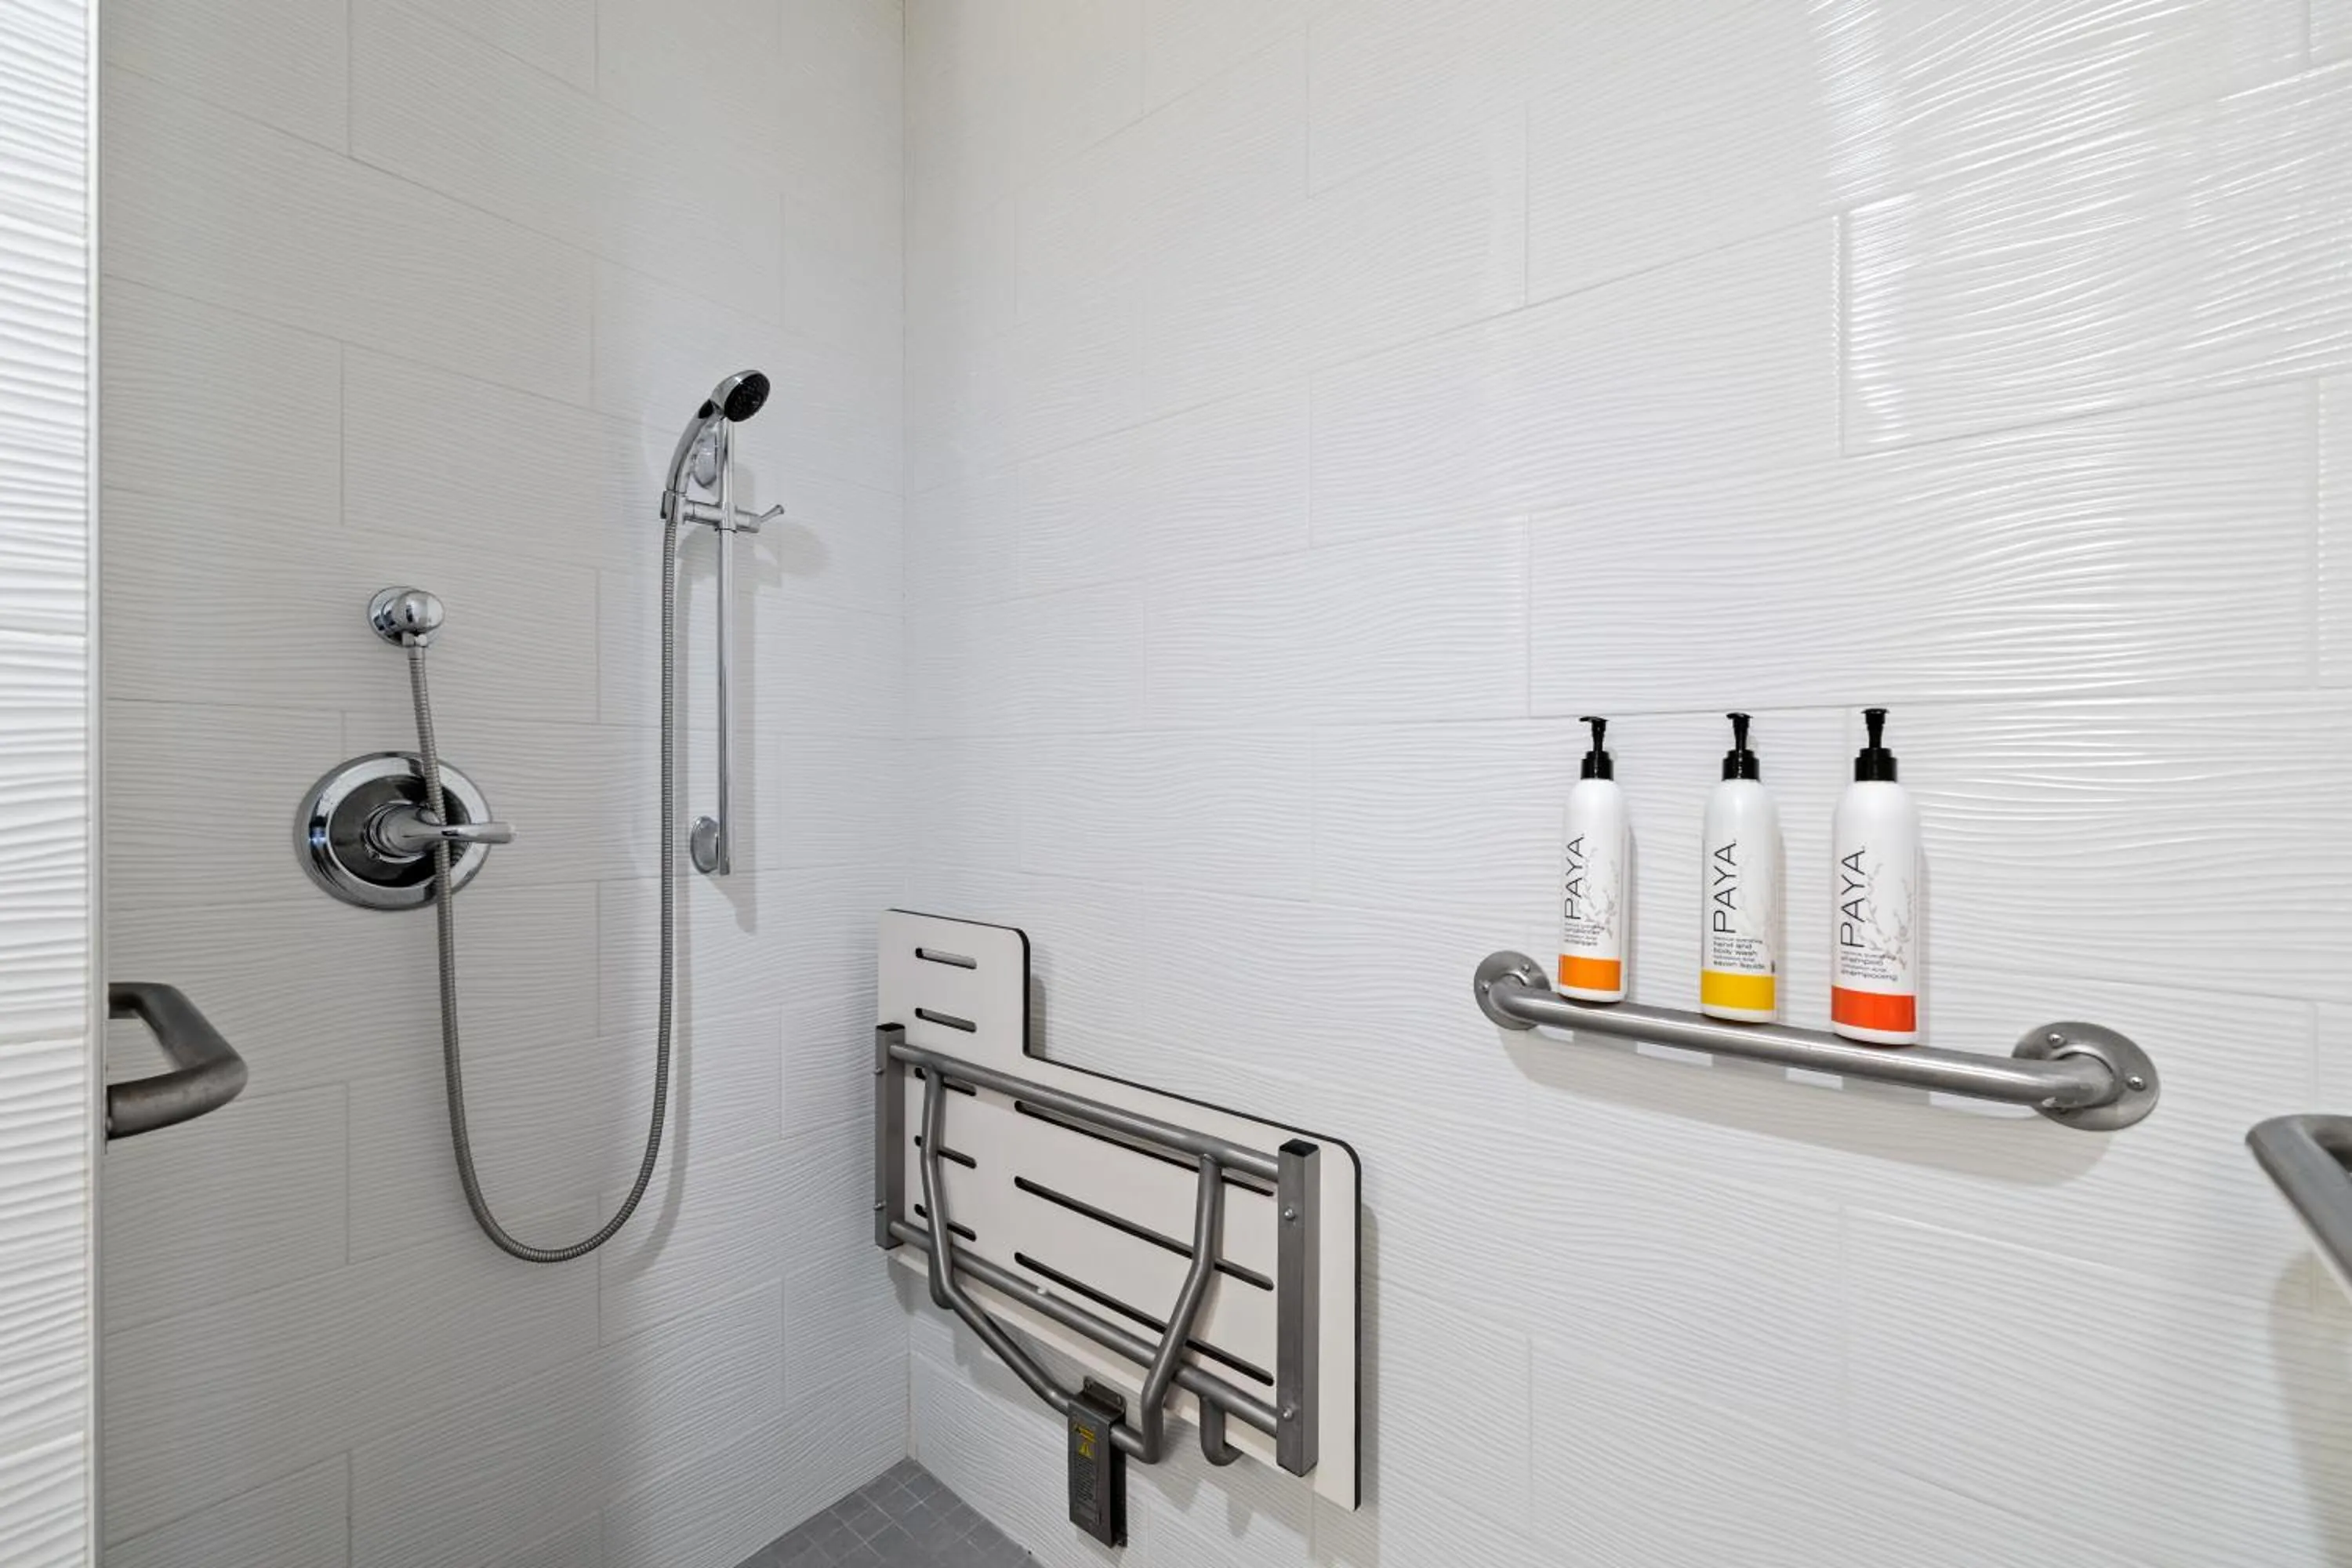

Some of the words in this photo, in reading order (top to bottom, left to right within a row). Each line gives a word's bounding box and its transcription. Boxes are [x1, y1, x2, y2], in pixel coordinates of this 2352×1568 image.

[1565, 837, 1584, 920] PAYA
[1713, 843, 1737, 933] PAYA
[1840, 849, 1865, 948] PAYA
